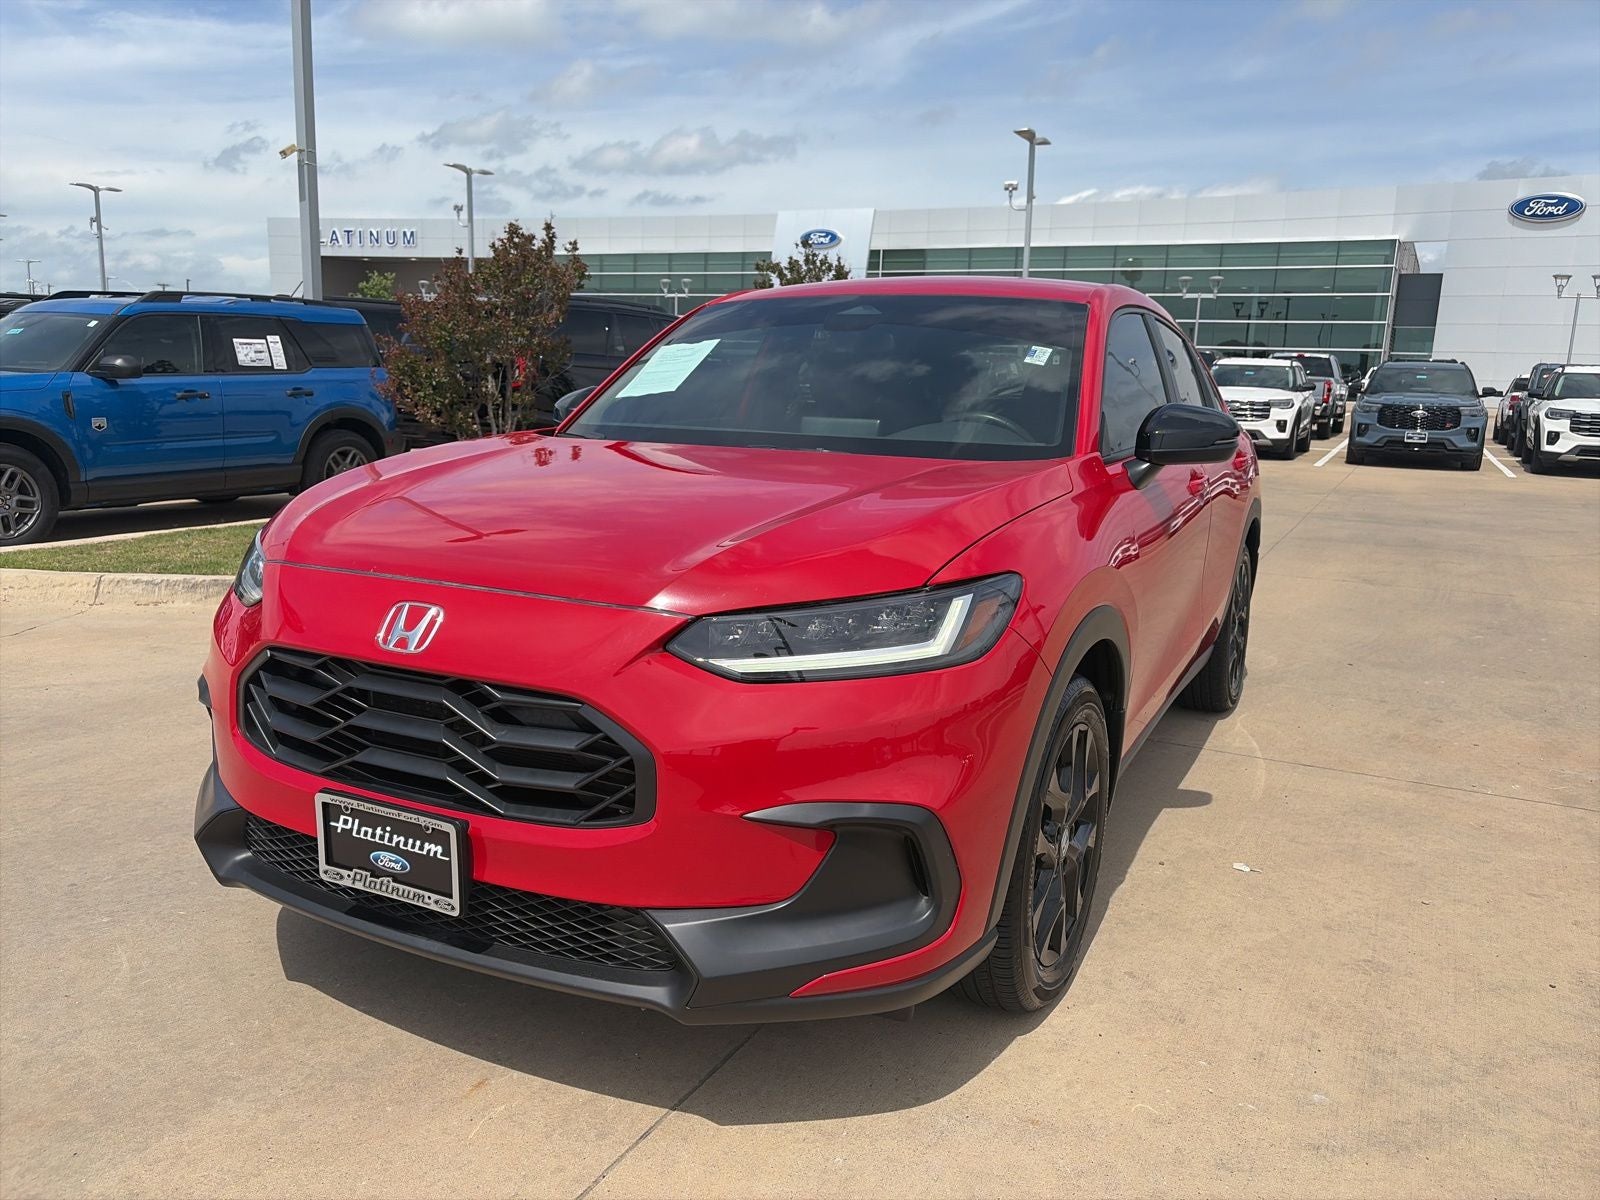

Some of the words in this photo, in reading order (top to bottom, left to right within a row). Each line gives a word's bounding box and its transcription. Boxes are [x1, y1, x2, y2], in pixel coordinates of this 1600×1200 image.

[1524, 198, 1568, 216] Ford
[320, 228, 416, 246] ATINUM
[808, 232, 832, 244] Ford
[329, 797, 443, 829] www.PlatinumFord.com
[329, 814, 450, 861] Platinum
[377, 853, 402, 871] Ford
[351, 870, 432, 906] Platinum
